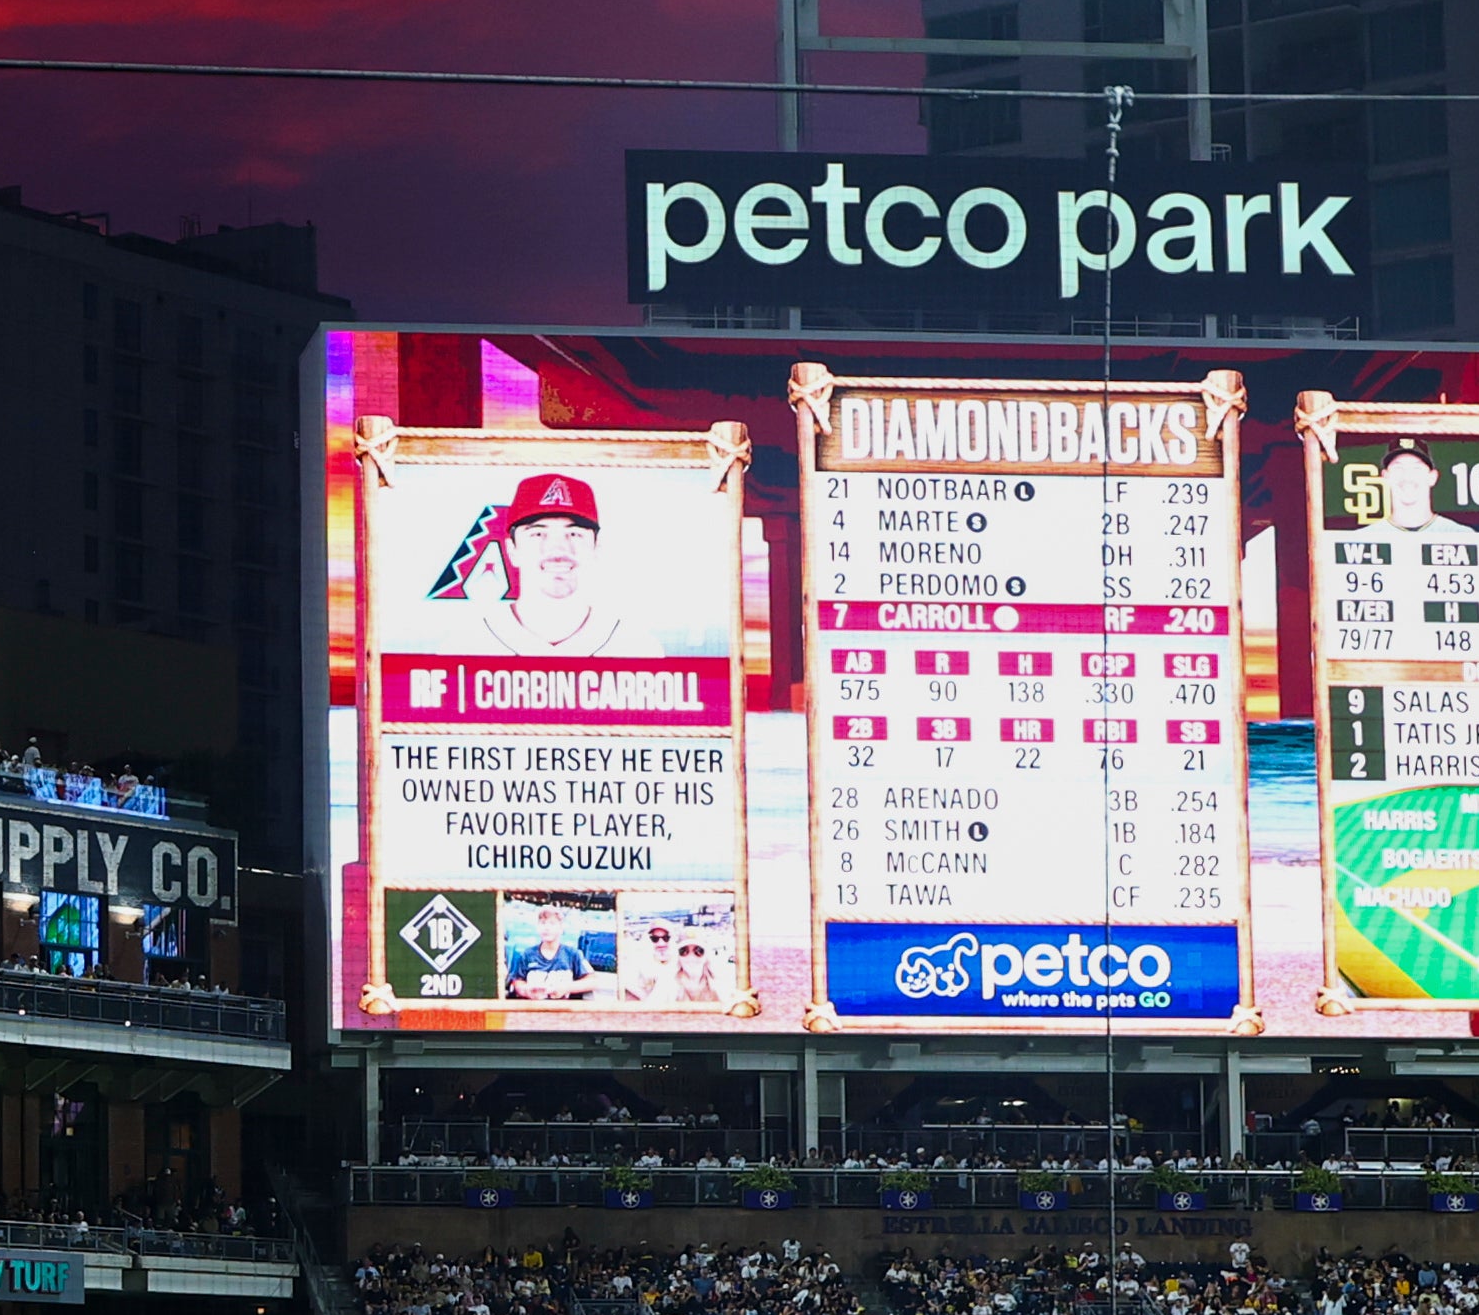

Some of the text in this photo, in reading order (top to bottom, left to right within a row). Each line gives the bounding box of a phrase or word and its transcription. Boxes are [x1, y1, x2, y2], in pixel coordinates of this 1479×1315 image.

[645, 162, 1356, 299] petco park
[841, 398, 1198, 465] DIAMONDBACKS
[878, 478, 1007, 501] NOOTBAAR
[878, 510, 959, 533] MARTE
[879, 542, 982, 565] MORENO
[879, 573, 998, 597] PERDOMO
[878, 604, 990, 631] CARROLL
[409, 668, 704, 712] RF CORBIN CARROLL
[1393, 691, 1469, 713] SALAS
[1394, 722, 1456, 744] TATIS
[391, 746, 724, 774] THE FIRST JERSEY HE EVER
[401, 779, 714, 806] OWNED WAS THAT OF HIS
[884, 788, 999, 810] ARENADO
[446, 812, 673, 841] FAVORITE PLAYER,
[885, 820, 960, 842] SMITH
[1363, 810, 1438, 831] HARRIS
[467, 845, 652, 871] ICHIRO SUZUKI
[886, 852, 988, 874] McCANN
[151, 841, 231, 911] CO.
[885, 884, 952, 906] TAWA
[1354, 887, 1452, 908] MACHADO
[980, 933, 1168, 1000] petco
[420, 974, 462, 997] 2ND
[1001, 991, 1171, 1011] where the pets GO
[1136, 1216, 1253, 1237] LANDING
[7, 1261, 70, 1295] TURF
